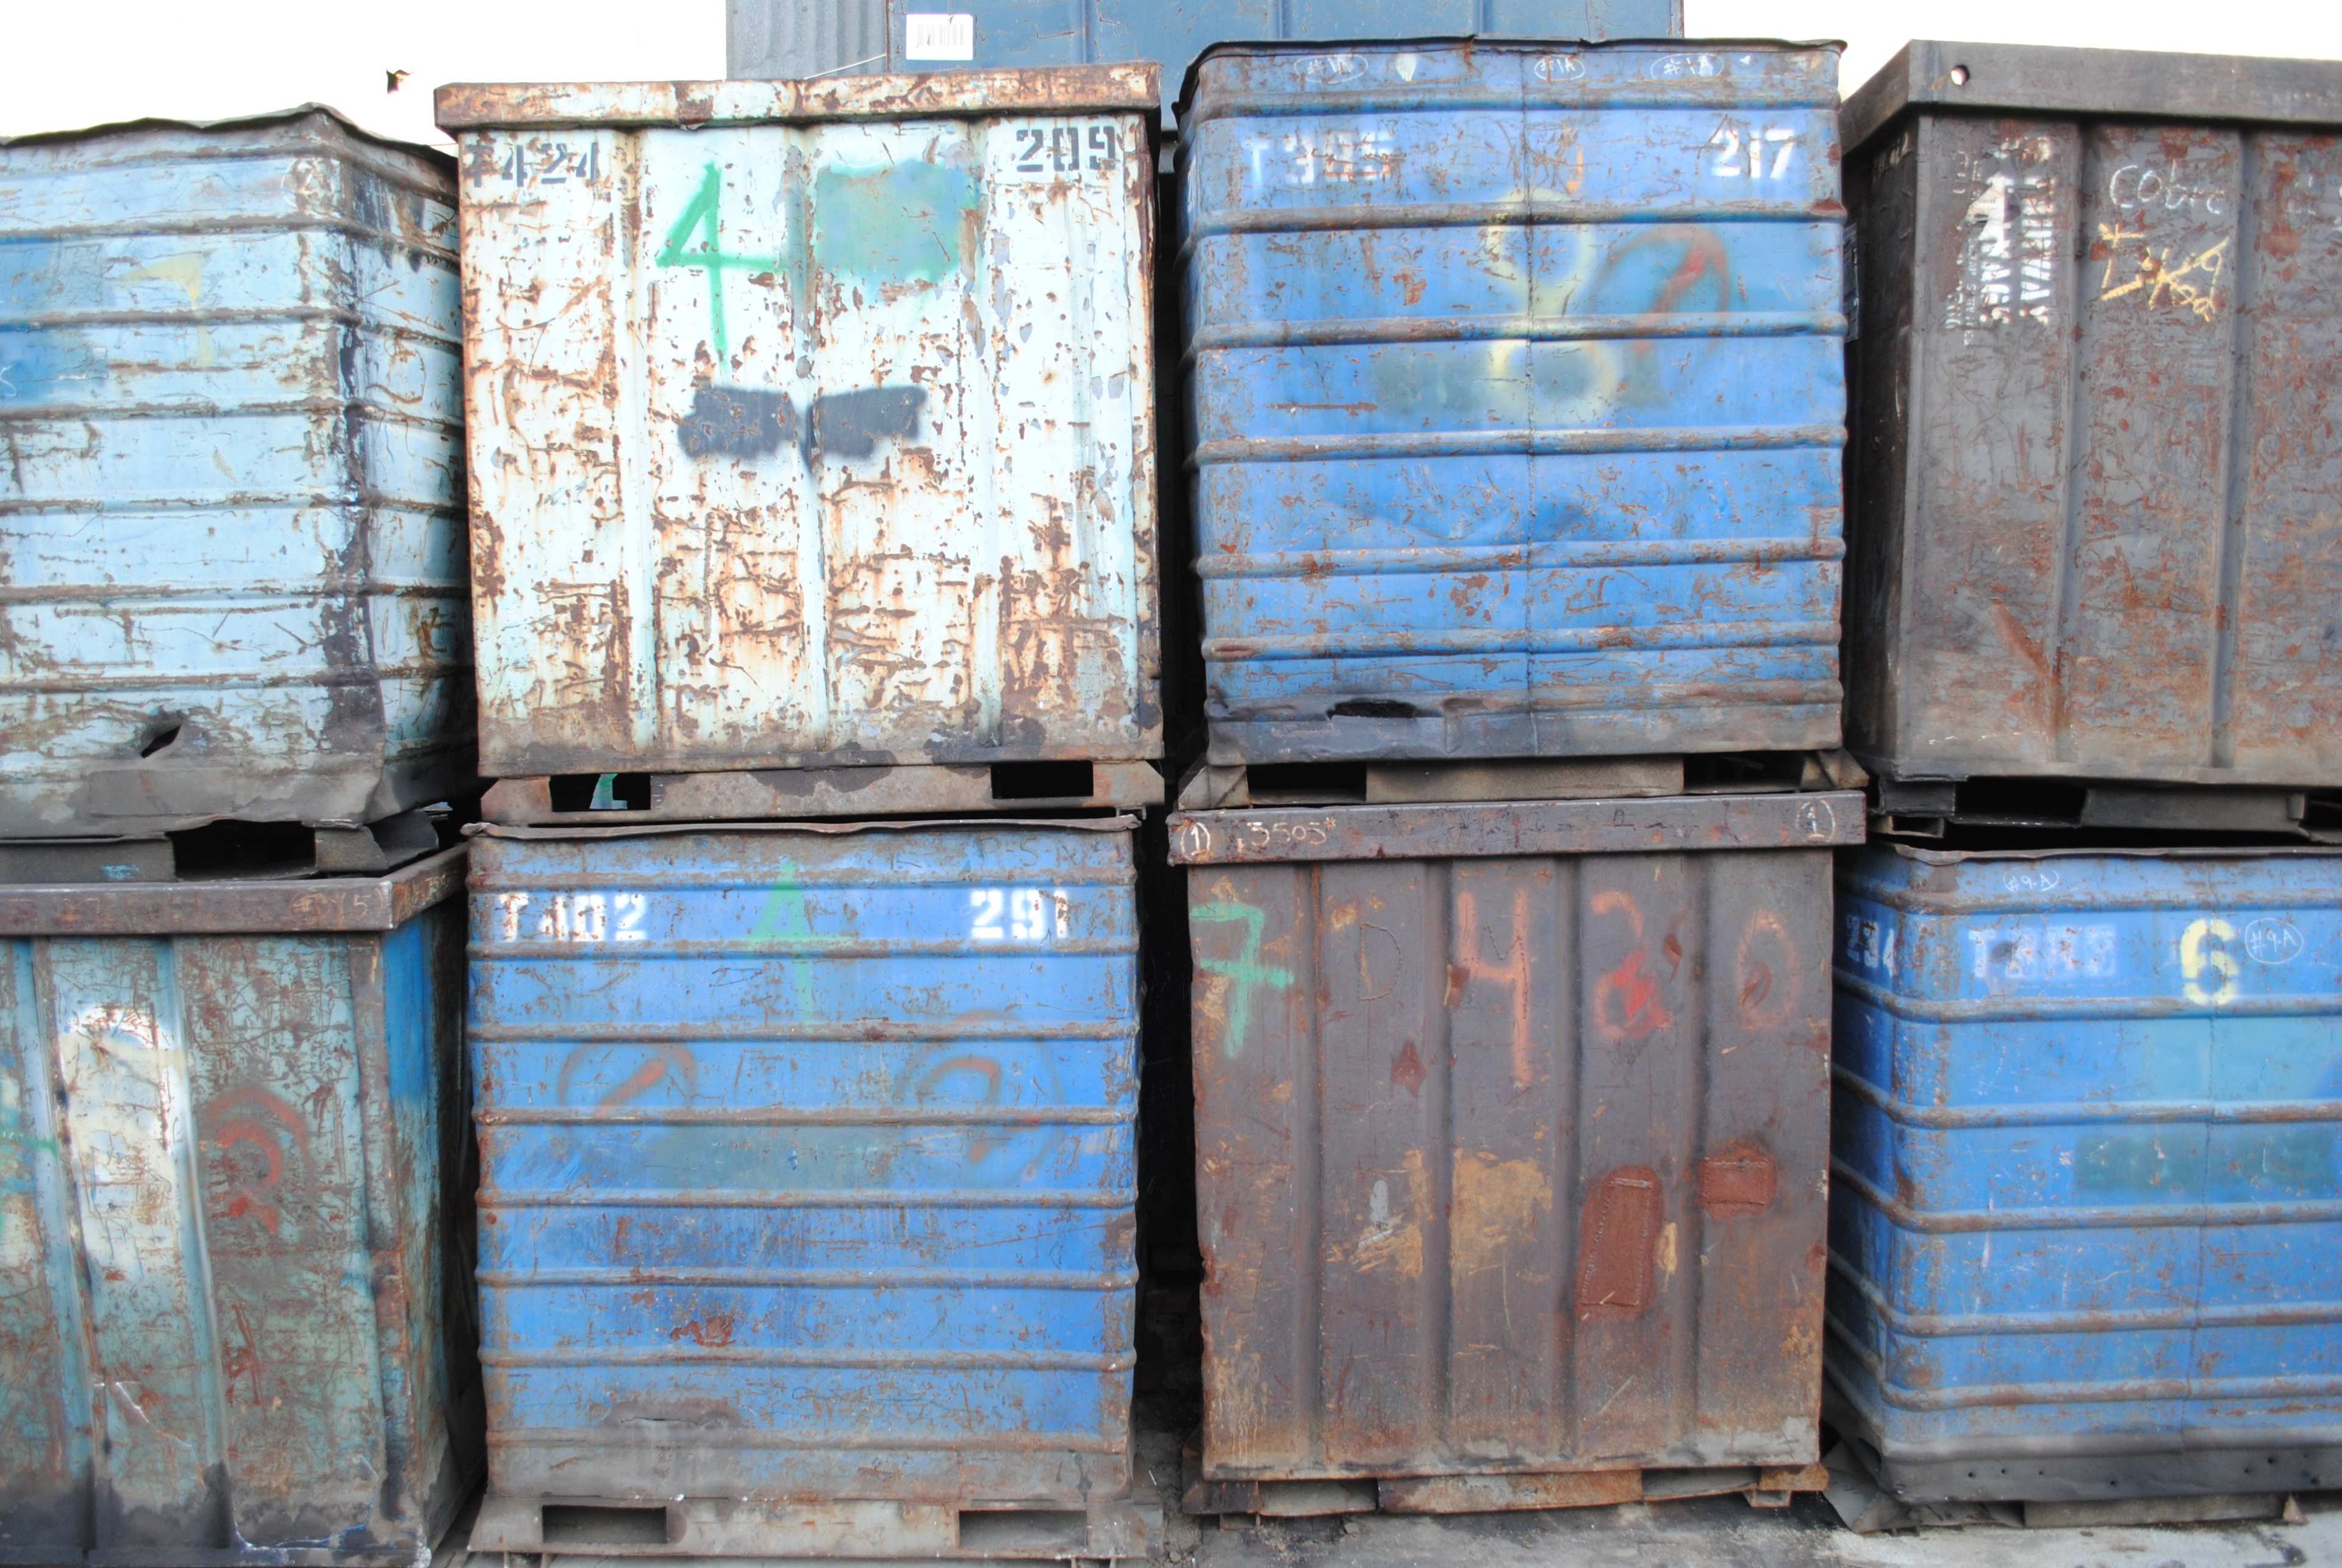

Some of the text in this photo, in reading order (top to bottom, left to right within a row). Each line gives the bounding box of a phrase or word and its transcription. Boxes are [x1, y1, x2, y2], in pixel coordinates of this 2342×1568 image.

[1014, 125, 1116, 173] 209
[1710, 127, 1796, 180] 217
[654, 160, 796, 381] 4
[2180, 918, 2240, 1006] 6
